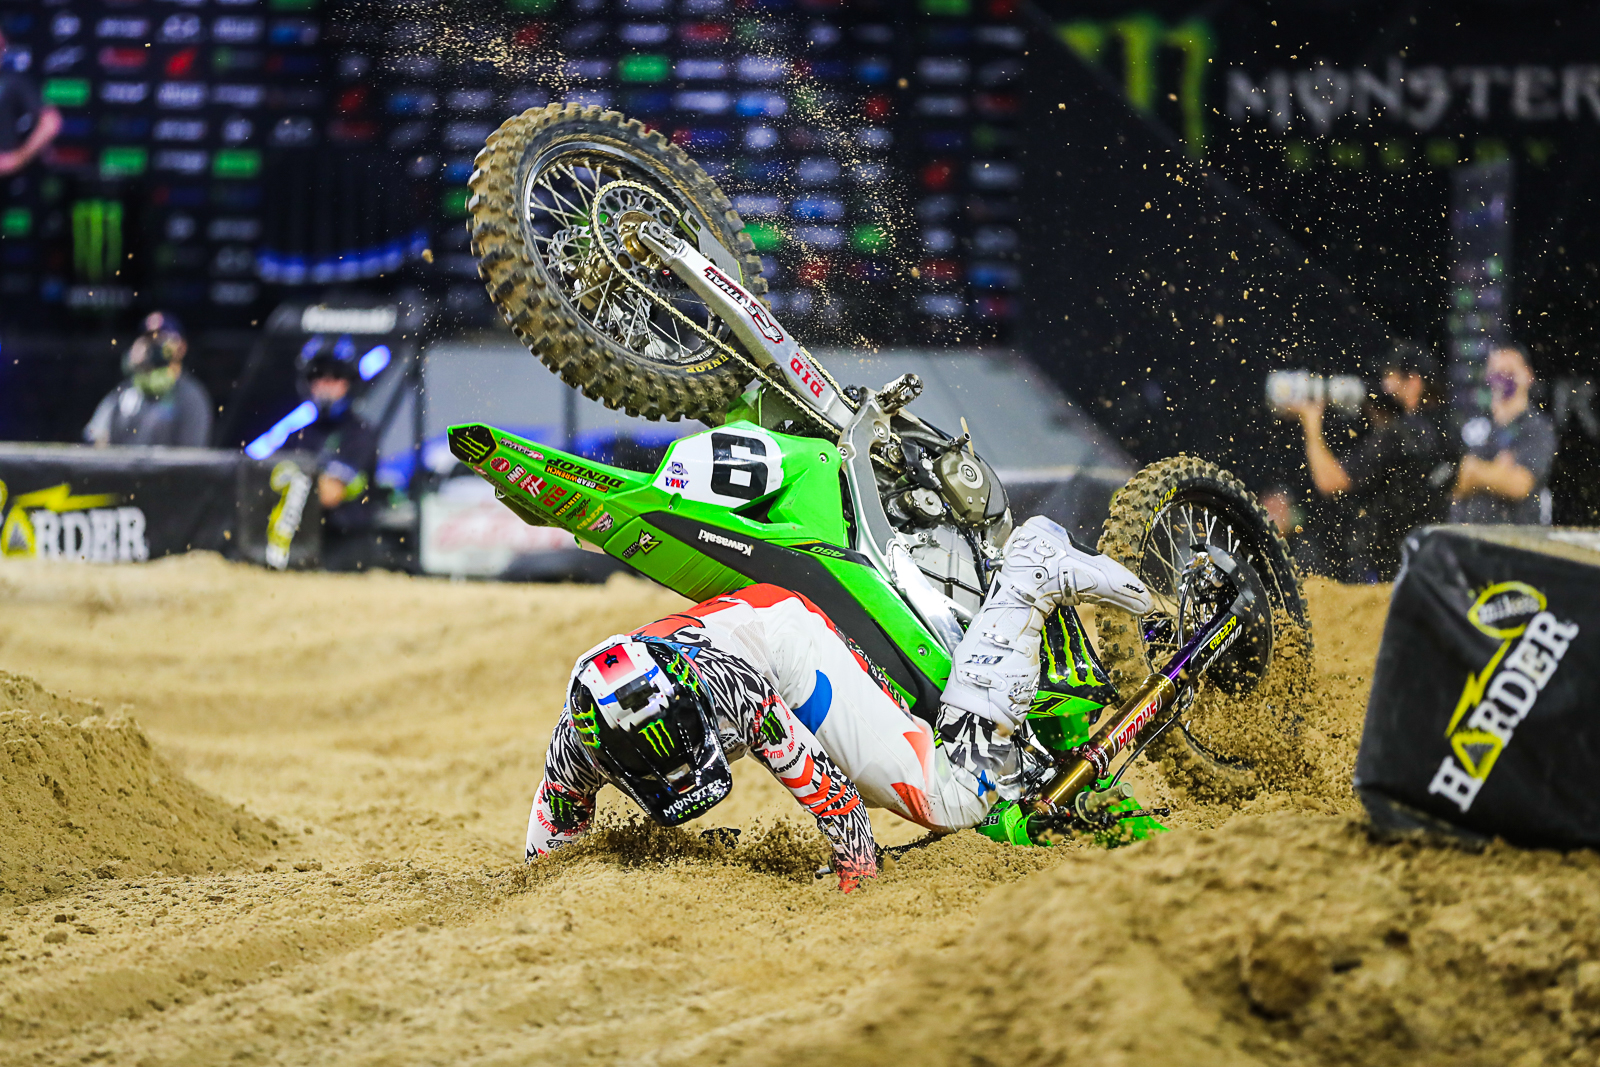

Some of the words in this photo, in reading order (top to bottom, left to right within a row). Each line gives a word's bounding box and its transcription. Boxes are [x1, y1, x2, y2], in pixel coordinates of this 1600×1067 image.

[507, 466, 524, 483] UNI
[546, 458, 625, 488] DUNLOP
[546, 465, 597, 489] GEARWRENCH
[664, 476, 691, 490] AMA
[555, 492, 582, 517] HINSON
[697, 528, 753, 557] Kawasaki
[810, 545, 847, 560] 450
[1428, 610, 1580, 814] HARDER
[1117, 701, 1159, 751] SHOWA
[773, 742, 806, 774] Kawasaki
